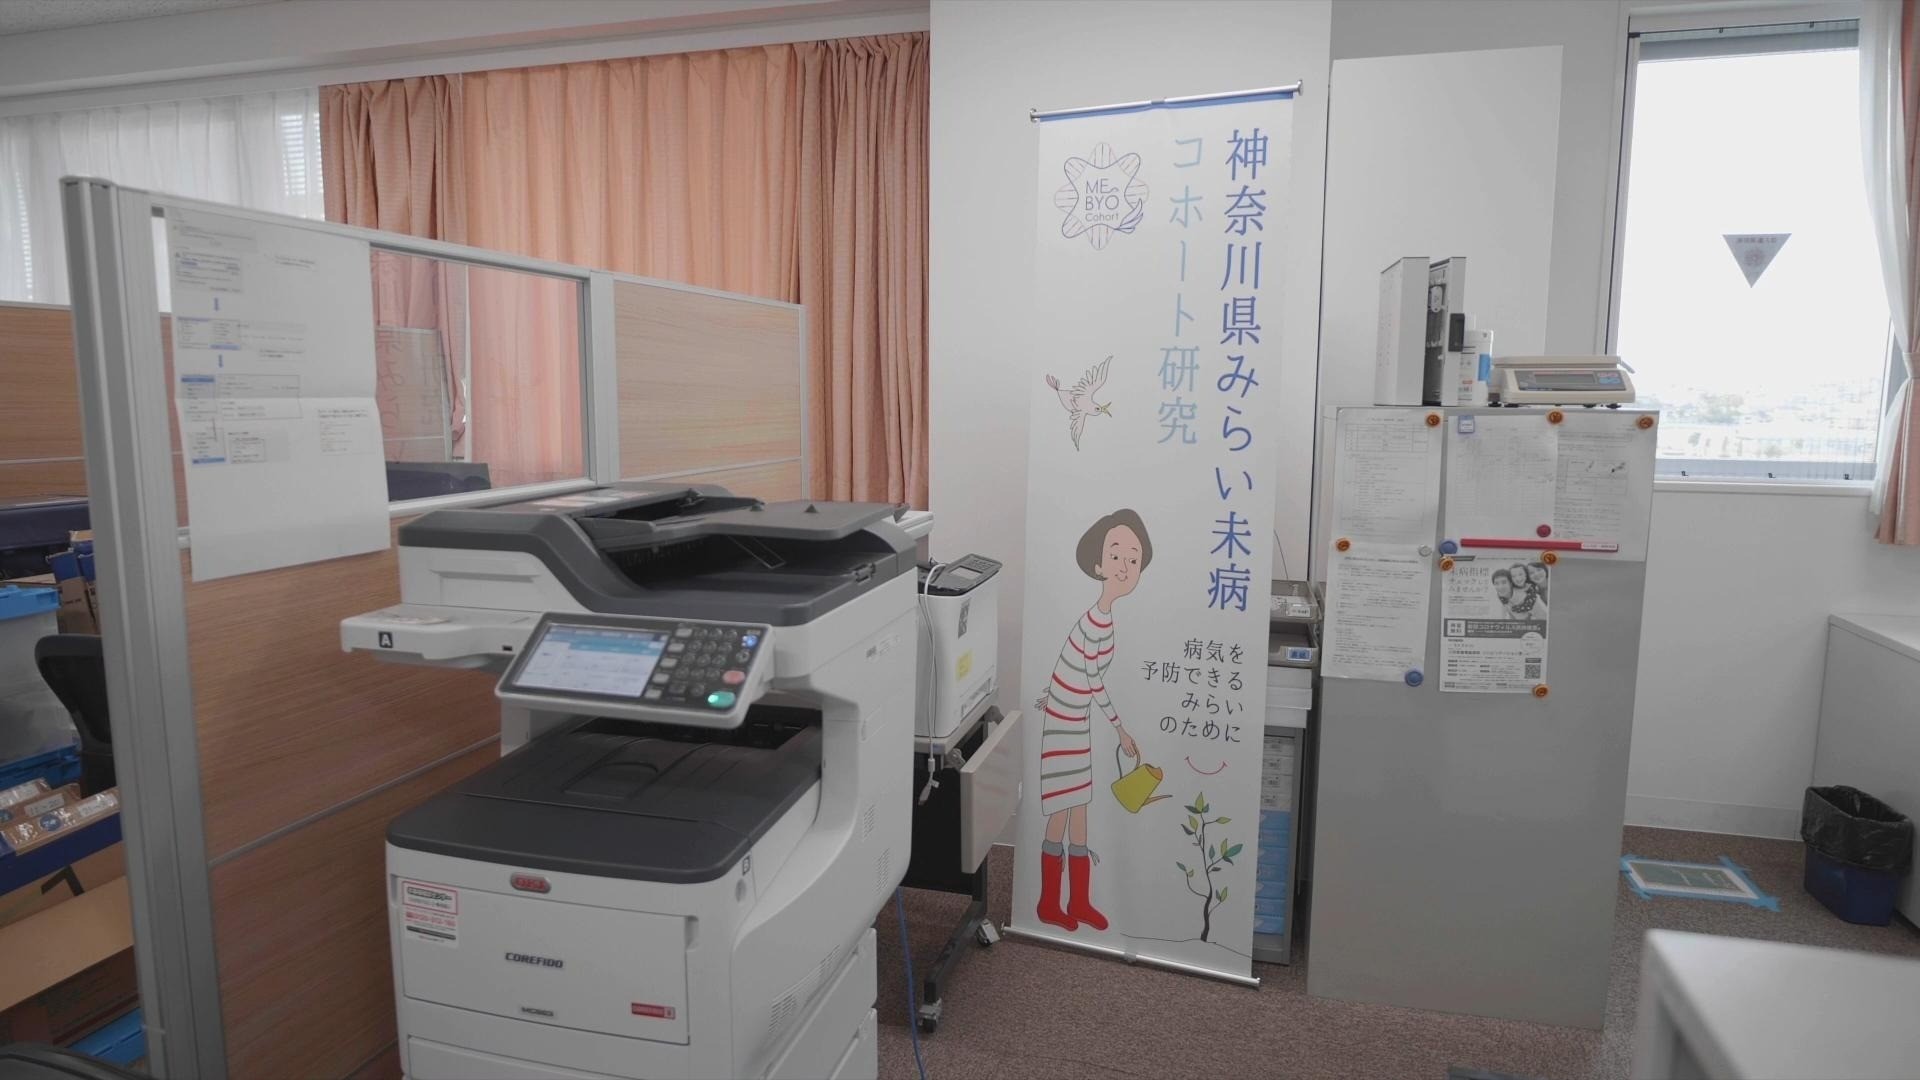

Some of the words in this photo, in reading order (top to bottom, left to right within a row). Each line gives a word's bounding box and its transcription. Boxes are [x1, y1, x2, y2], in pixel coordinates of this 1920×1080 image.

[1086, 178, 1119, 194] ME
[1085, 195, 1120, 211] BYO
[1085, 212, 1119, 222] Cohort
[1157, 137, 1203, 445] コホート研究
[1207, 127, 1269, 612] 神奈川県みらい未病
[380, 632, 392, 647] A
[1184, 638, 1244, 665] 病気を
[1141, 661, 1243, 691] 予防できる
[1181, 692, 1243, 716] みらい
[1160, 717, 1241, 743] のために
[505, 952, 564, 969] COREFIDO
